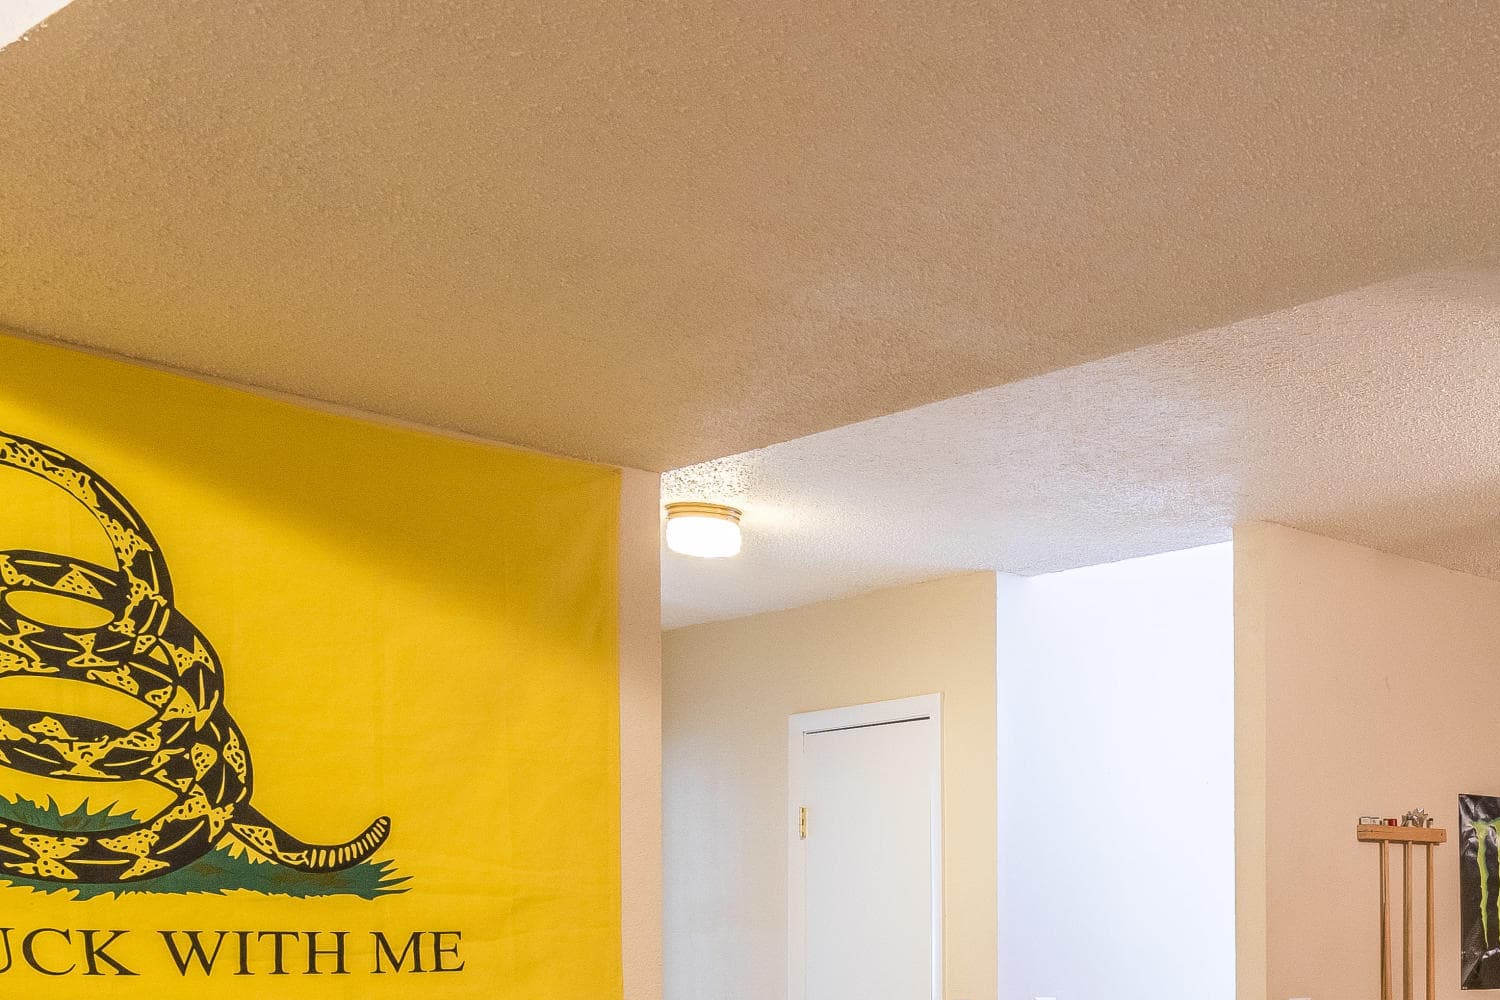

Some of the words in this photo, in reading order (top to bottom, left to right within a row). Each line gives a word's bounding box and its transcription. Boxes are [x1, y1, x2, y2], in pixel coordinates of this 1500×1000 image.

[0, 928, 140, 976] CK
[157, 930, 352, 976] WITH
[370, 930, 466, 974] ME
